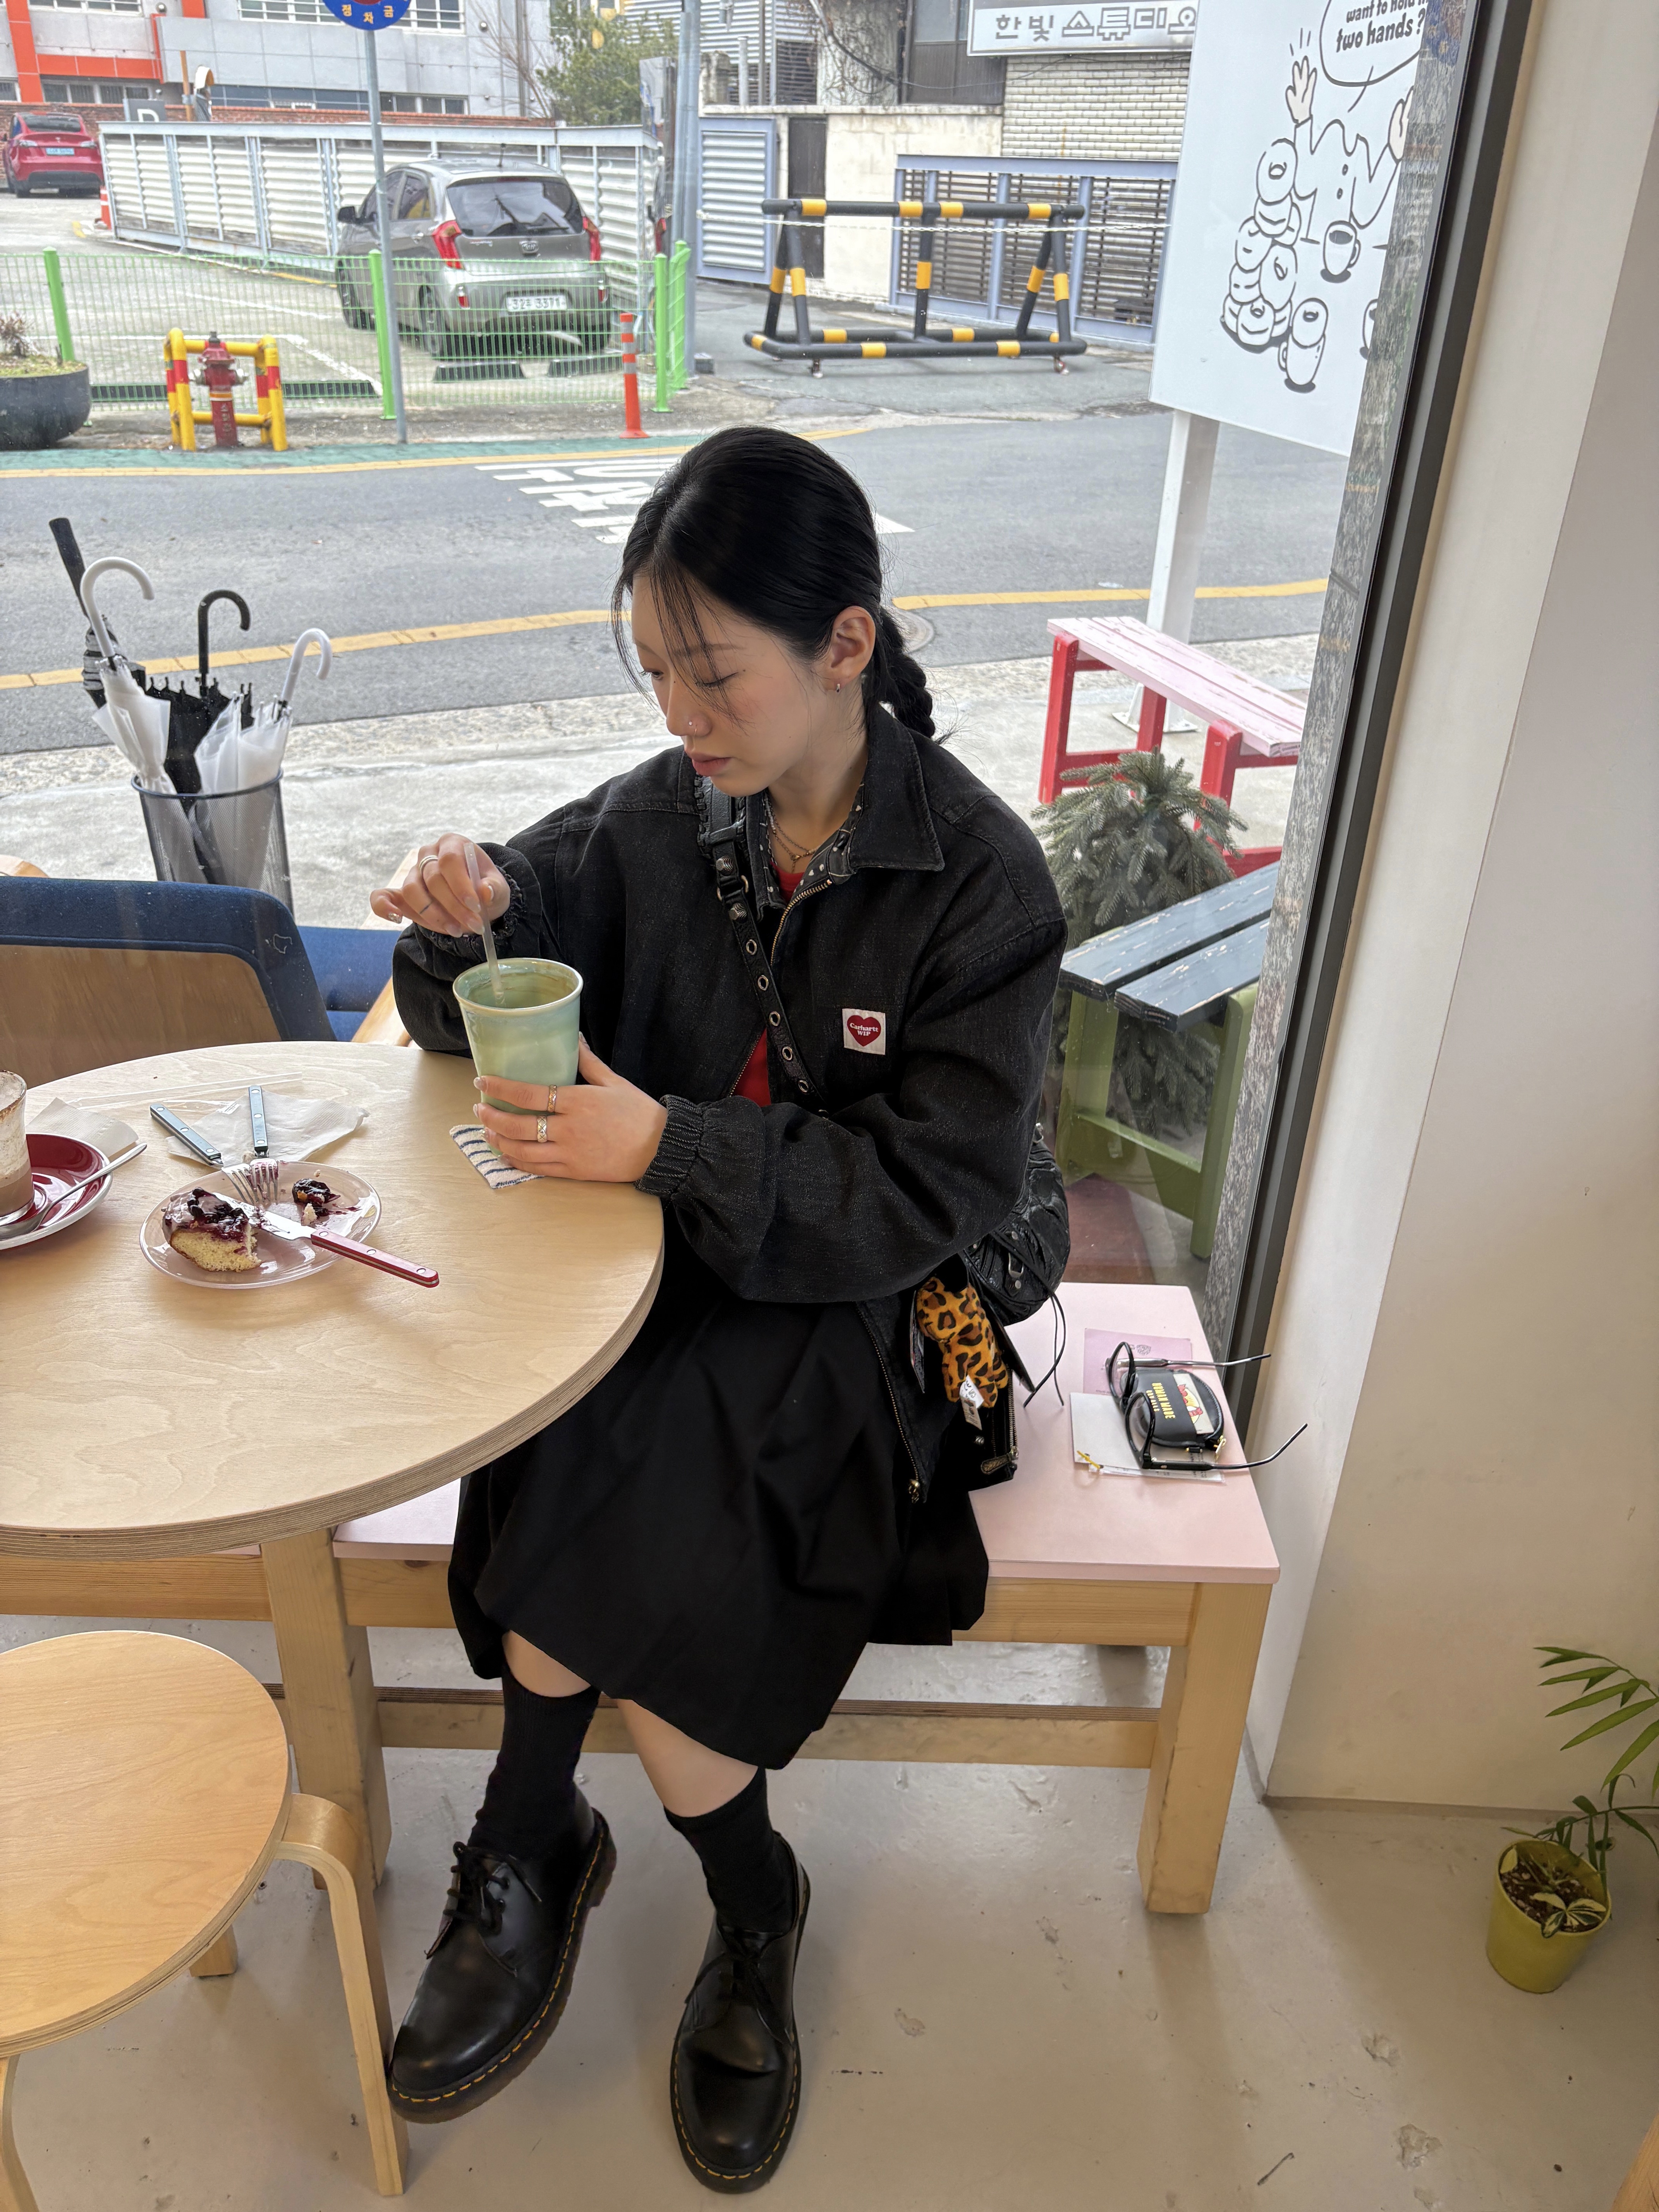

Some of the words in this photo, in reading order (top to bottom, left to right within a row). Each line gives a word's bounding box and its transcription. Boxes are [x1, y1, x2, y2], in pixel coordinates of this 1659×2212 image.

[995, 14, 1054, 42] 한빛
[1061, 6, 1196, 41] 스튜디오
[1346, 0, 1375, 23] want
[1376, 0, 1388, 16] to
[1336, 28, 1363, 53] two
[850, 1022, 879, 1032] Carhartt
[1152, 1382, 1168, 1401] HUMAN
[1160, 1402, 1176, 1419] MADE
